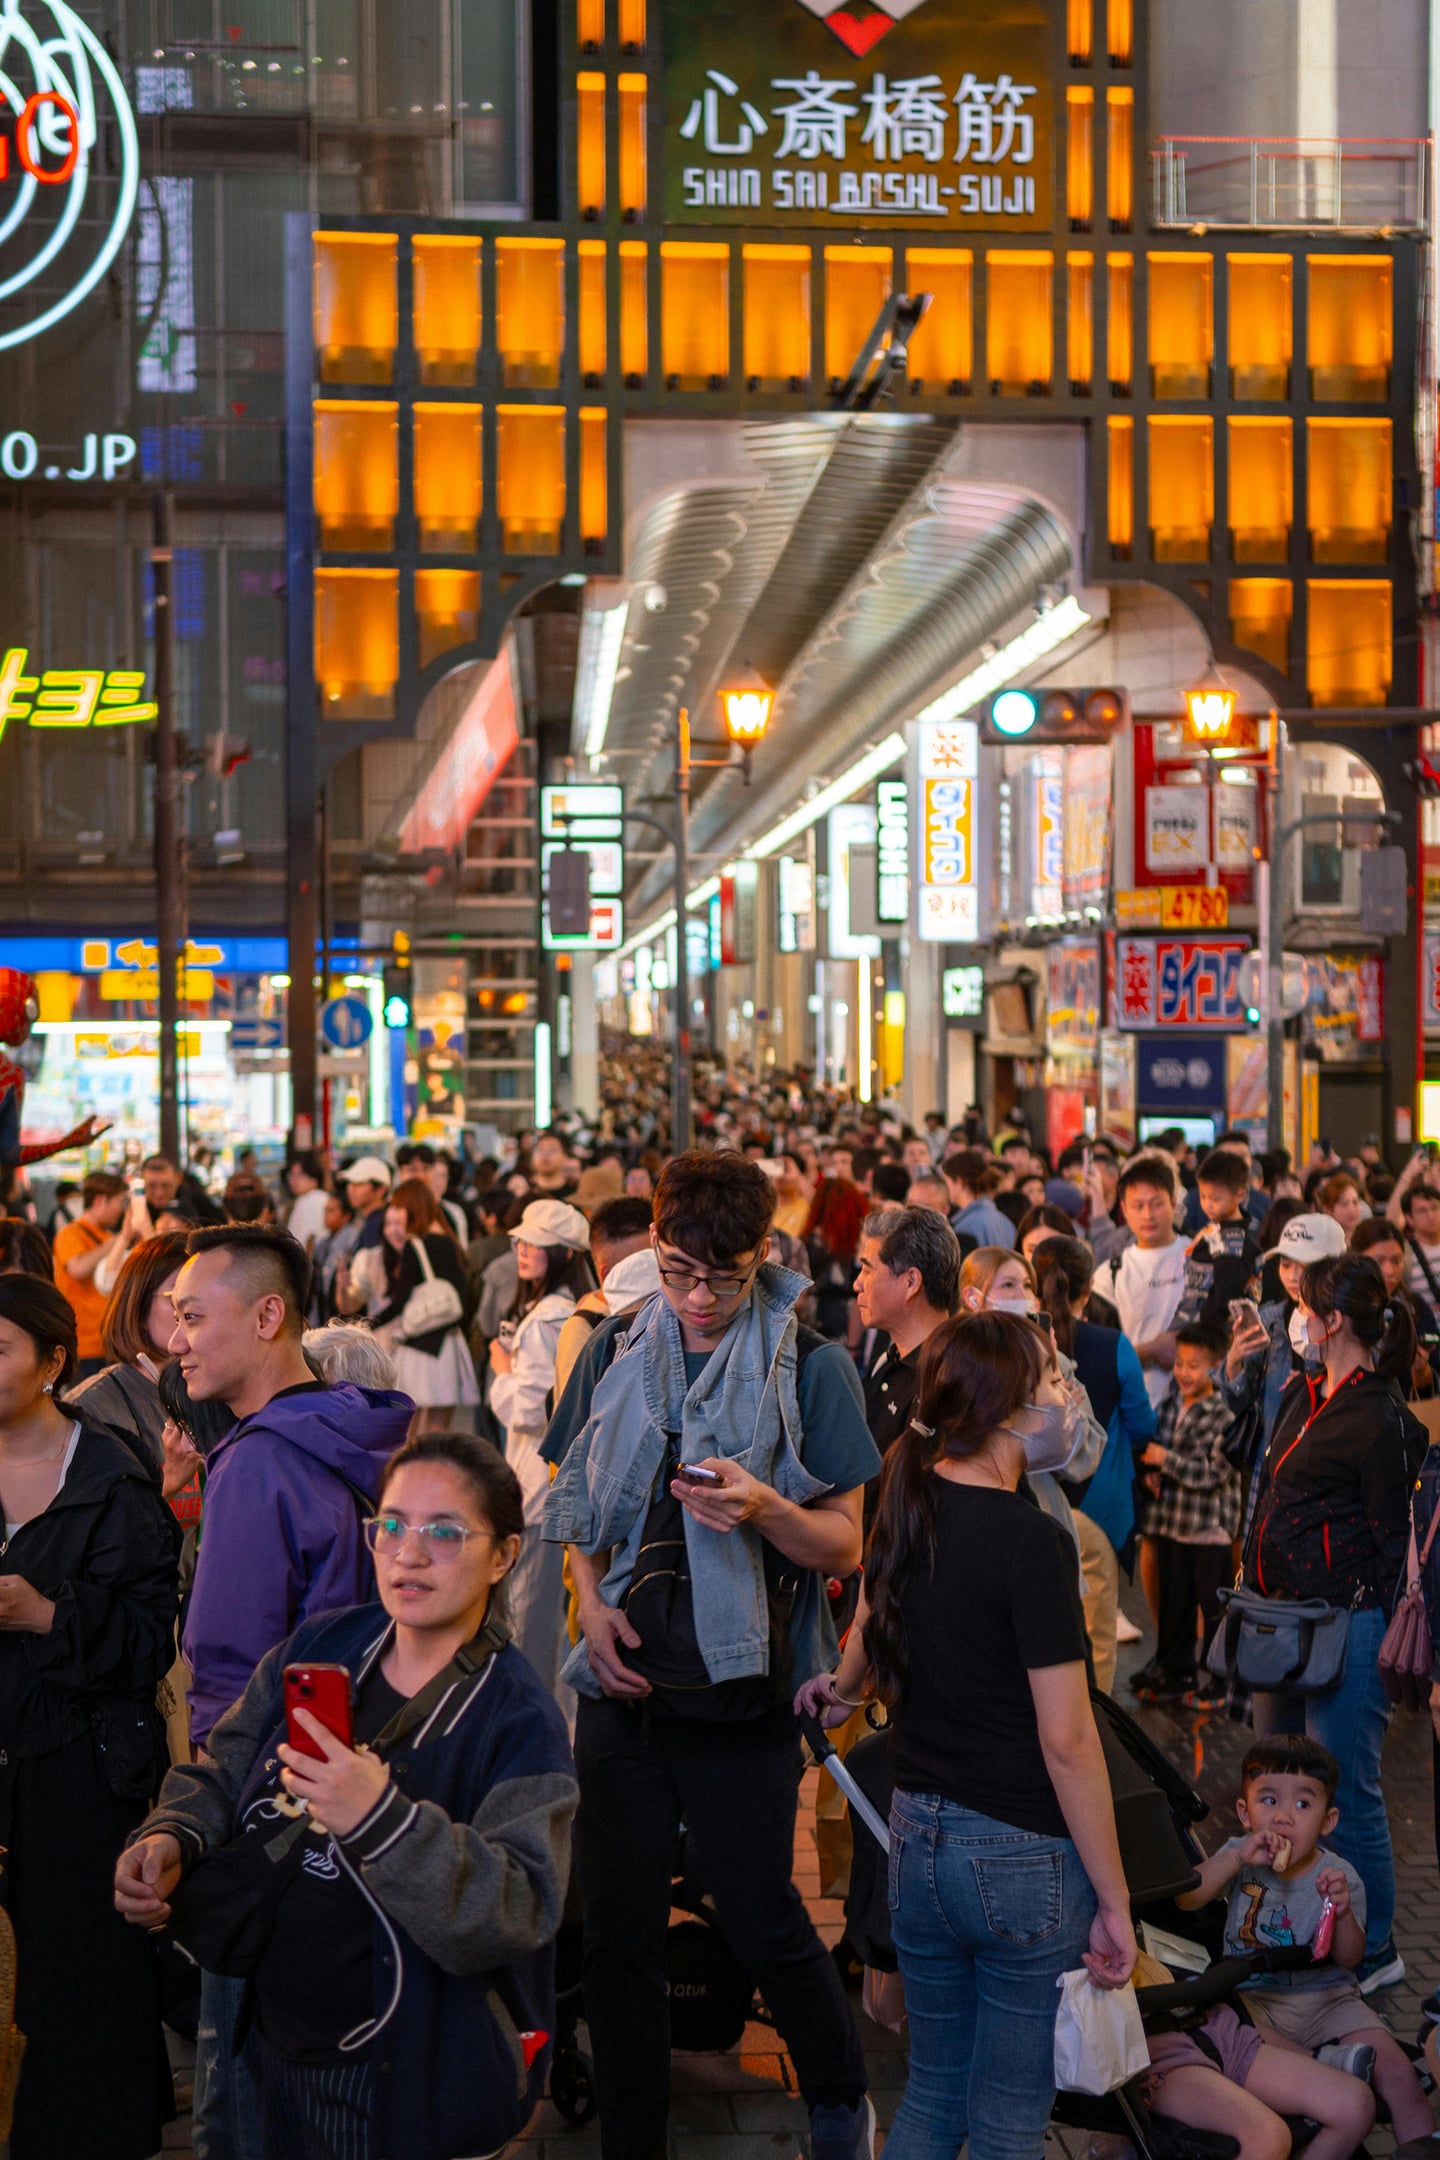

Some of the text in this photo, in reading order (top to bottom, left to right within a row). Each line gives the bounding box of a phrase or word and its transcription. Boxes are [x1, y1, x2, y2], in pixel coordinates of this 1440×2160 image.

[679, 70, 1037, 164] 心斎橋筋
[683, 168, 761, 206] SHIN
[772, 170, 828, 209] SAI
